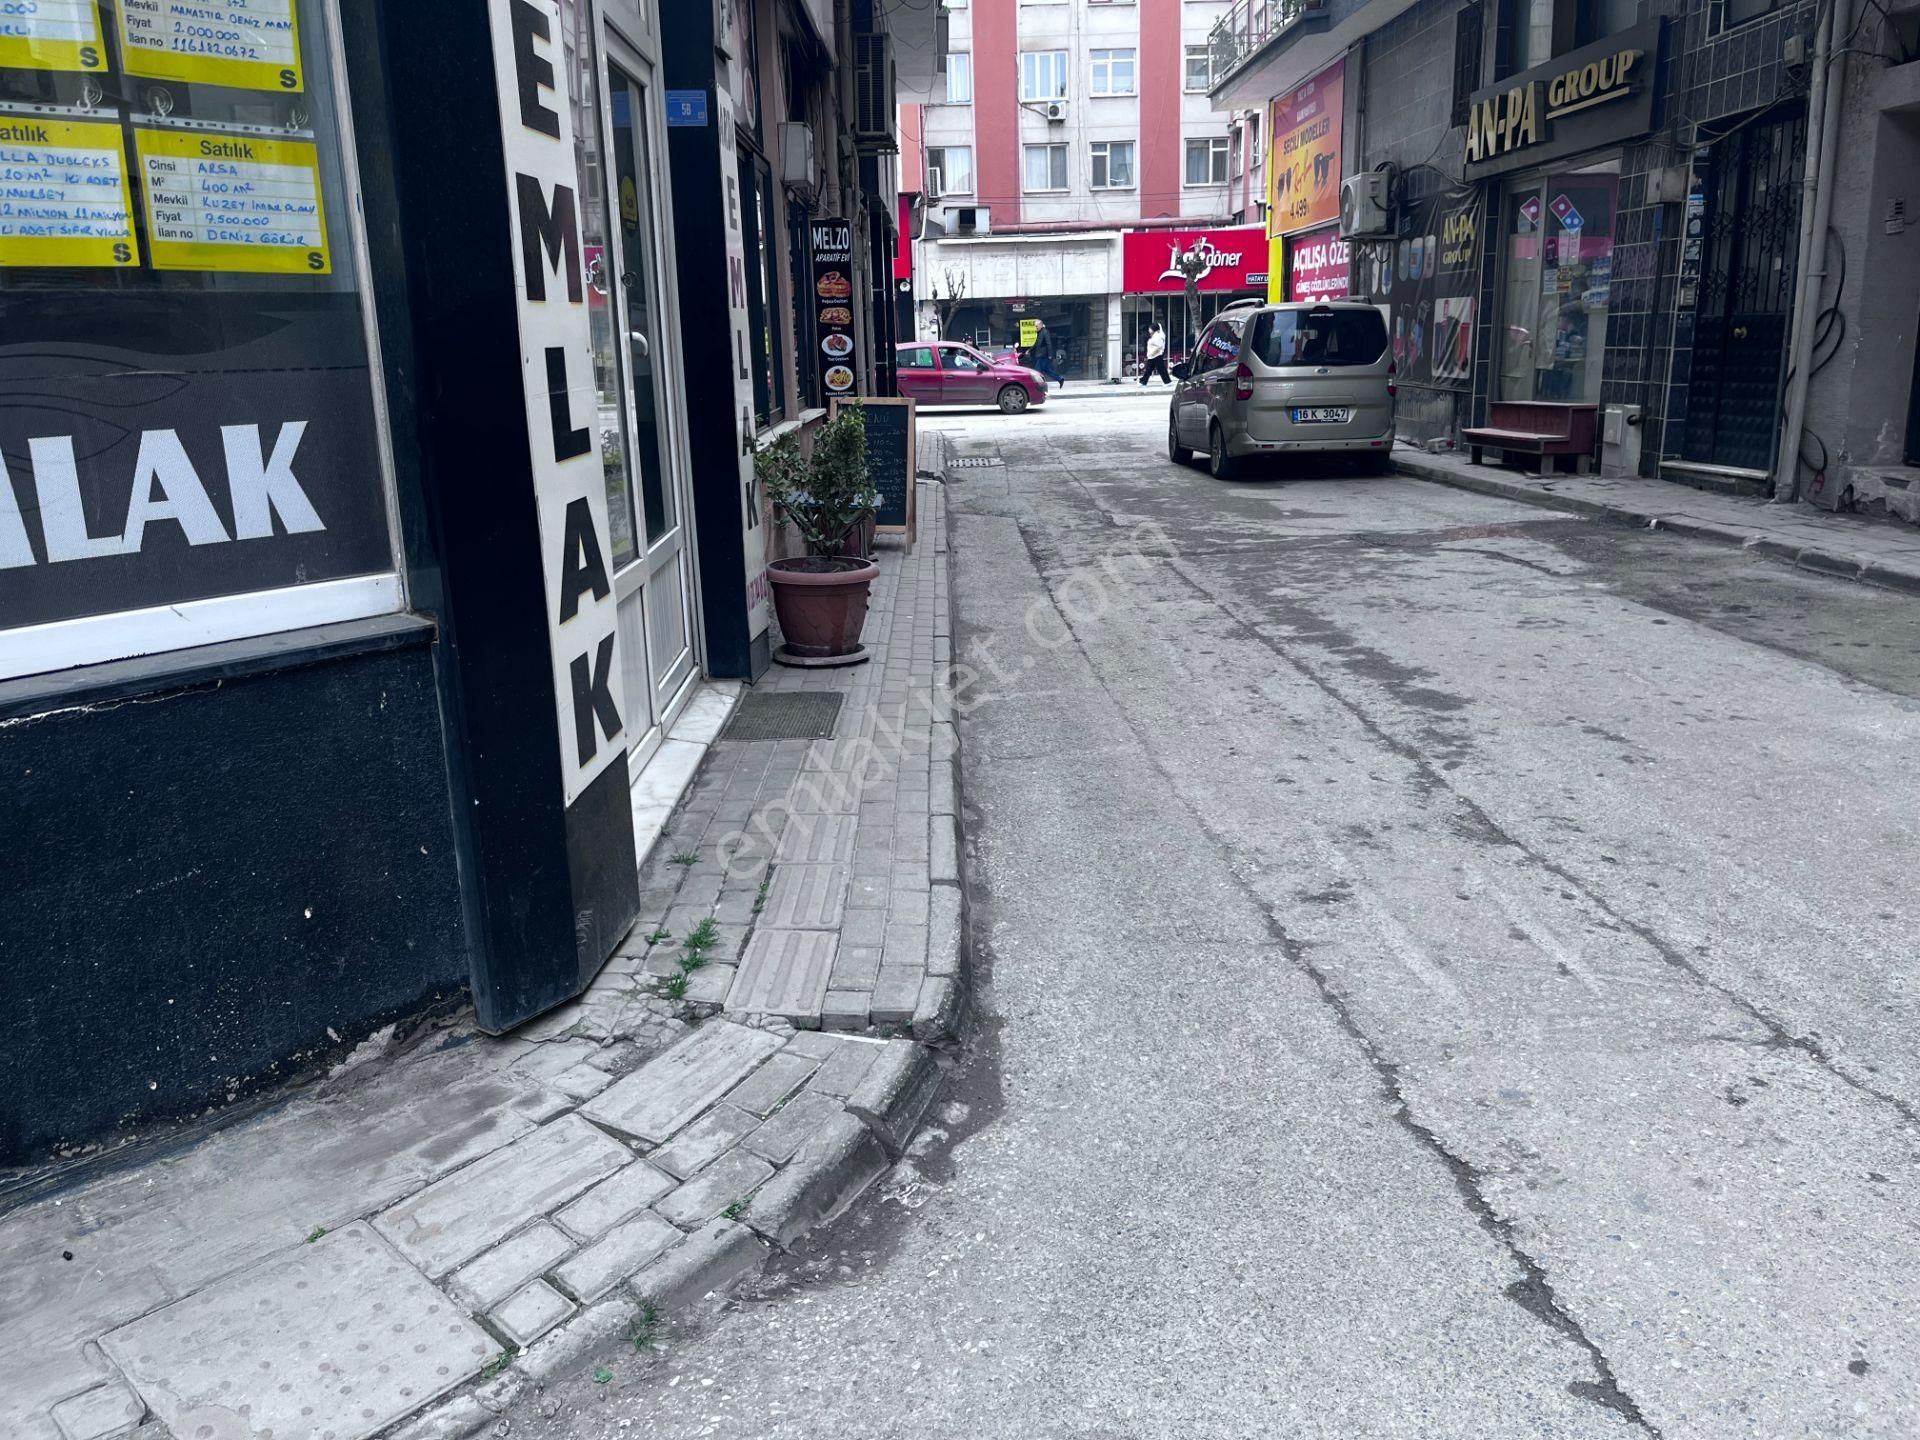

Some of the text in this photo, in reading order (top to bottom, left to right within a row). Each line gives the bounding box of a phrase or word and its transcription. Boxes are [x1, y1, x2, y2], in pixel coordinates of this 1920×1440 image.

[126, 14, 152, 29] Fiyat
[150, 38, 164, 47] no
[1463, 50, 1635, 165] AN-PA GROUP
[0, 125, 49, 143] atılık
[200, 139, 254, 160] Satılık
[148, 159, 176, 172] Cinsi
[201, 179, 229, 194] 400
[153, 193, 189, 206] Mevkii
[156, 209, 182, 223] Fiyat
[180, 228, 194, 240] no
[812, 226, 850, 251] MELZO
[1293, 235, 1350, 278] AÇILIŞA ÖZE
[1442, 248, 1473, 265] GROUP
[726, 175, 760, 531] EMLAK
[509, 0, 624, 770] EMLAK
[1298, 409, 1346, 419] 16 K 3047
[0, 421, 327, 570] LAK
